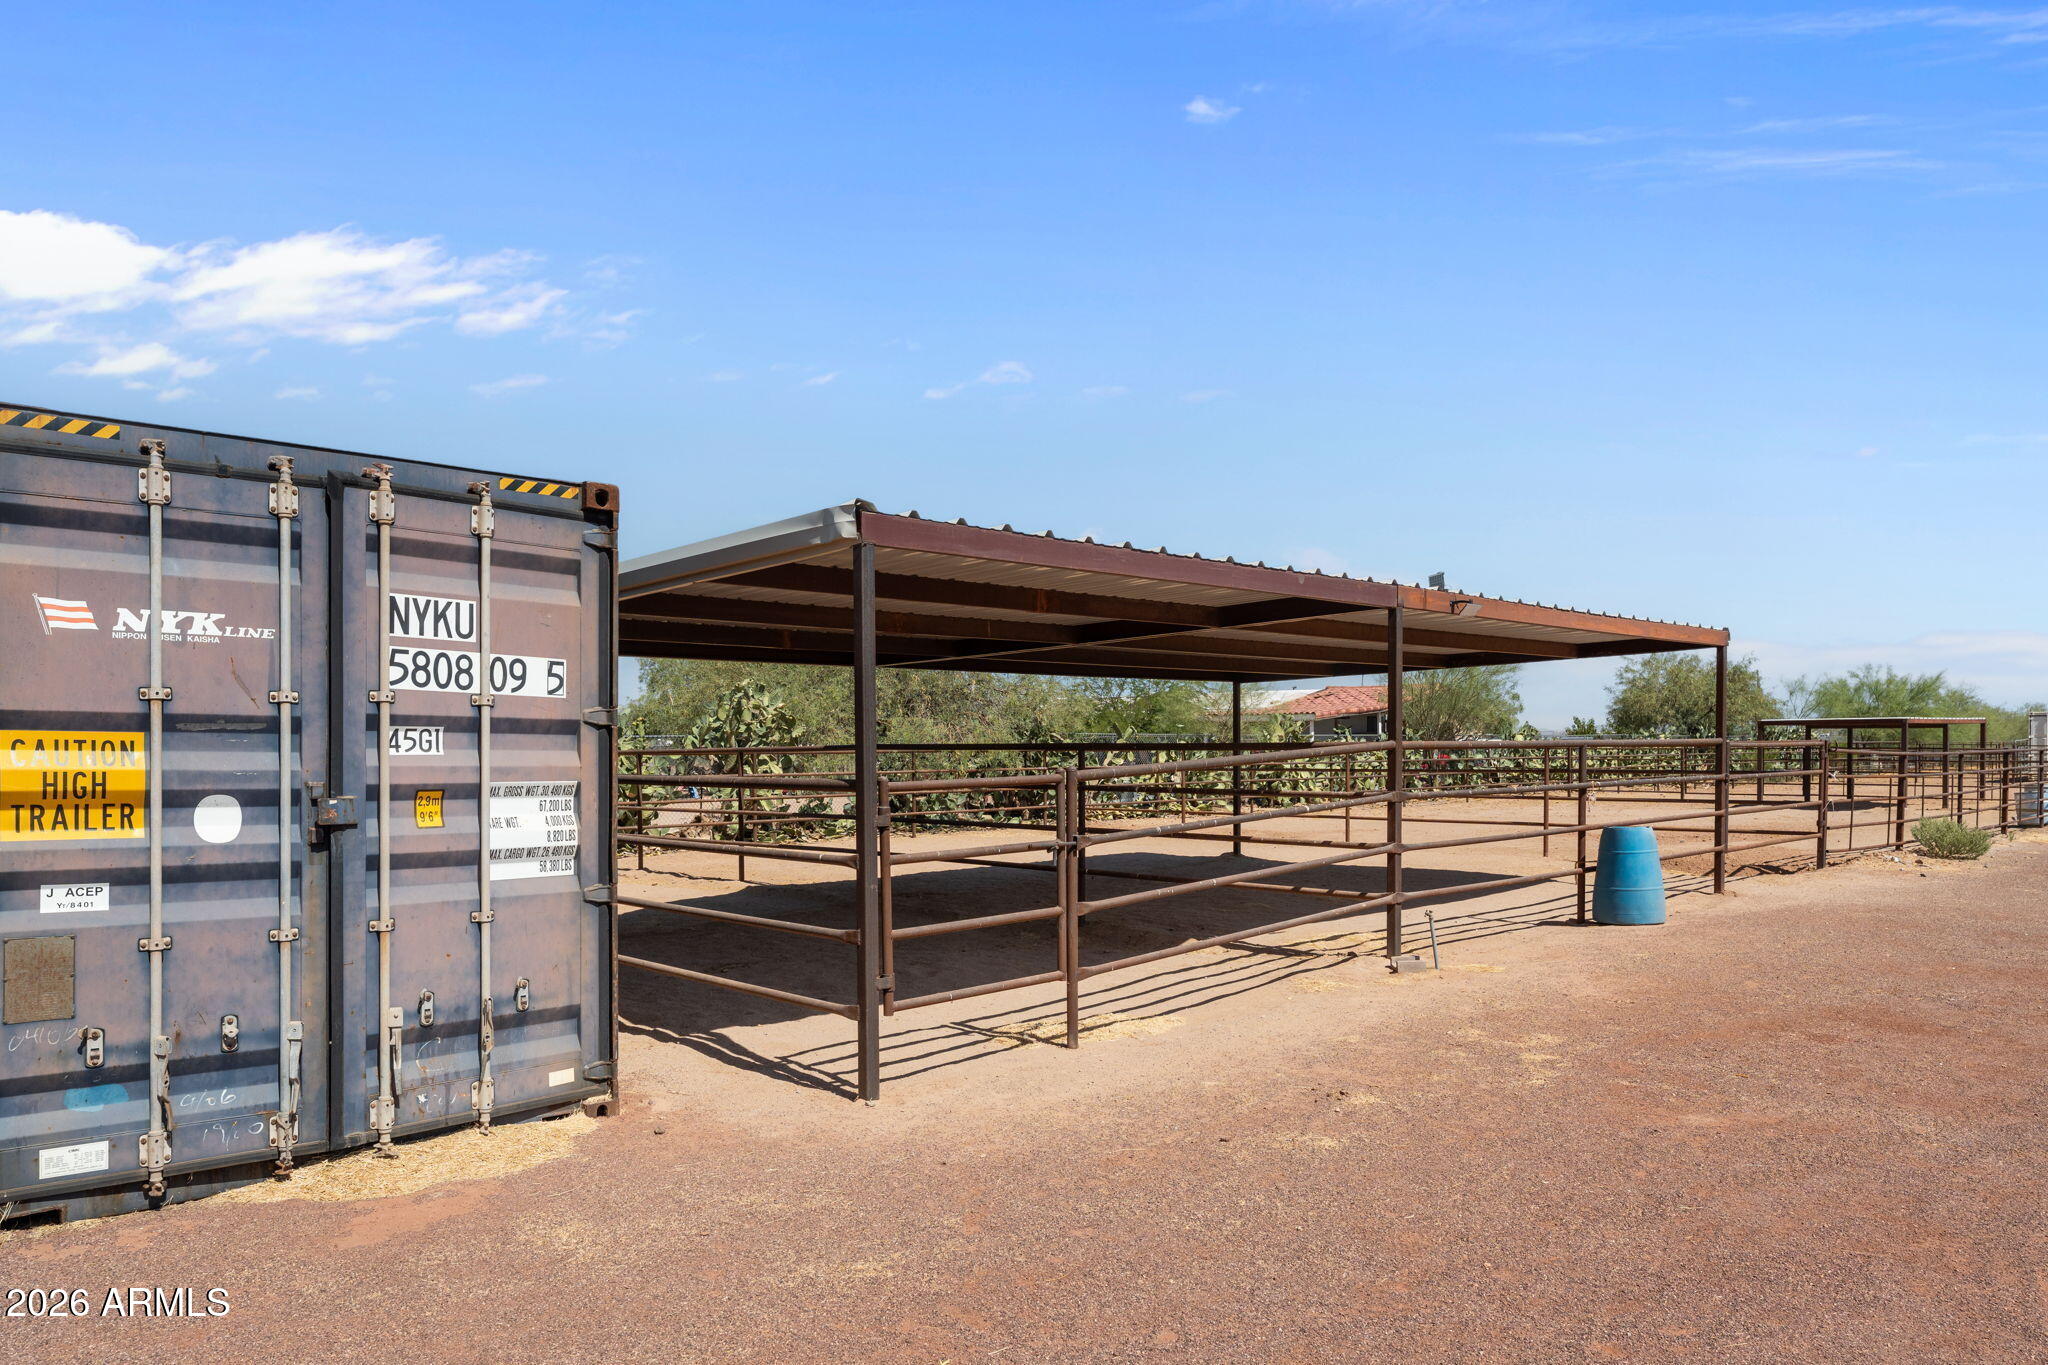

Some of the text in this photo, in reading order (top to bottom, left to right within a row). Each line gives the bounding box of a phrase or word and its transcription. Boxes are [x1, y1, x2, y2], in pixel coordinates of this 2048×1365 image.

[113, 608, 276, 640] NYK LINE
[389, 595, 474, 640] NYKU
[112, 632, 220, 645] NIPPON SEN KAISHA
[547, 661, 564, 695] 5
[10, 738, 136, 767] CAUTION
[42, 771, 107, 800] HIGH
[503, 785, 523, 797] GROSS
[562, 784, 575, 796] KGS
[560, 799, 572, 812] LBS
[10, 803, 135, 833] TRAILER
[490, 817, 504, 829] ARE
[562, 814, 575, 826] KGS
[564, 829, 576, 841] LBS
[503, 847, 525, 860] CARGO
[562, 844, 576, 856] KGS
[560, 858, 572, 871] LBS
[46, 886, 103, 898] J ACEP
